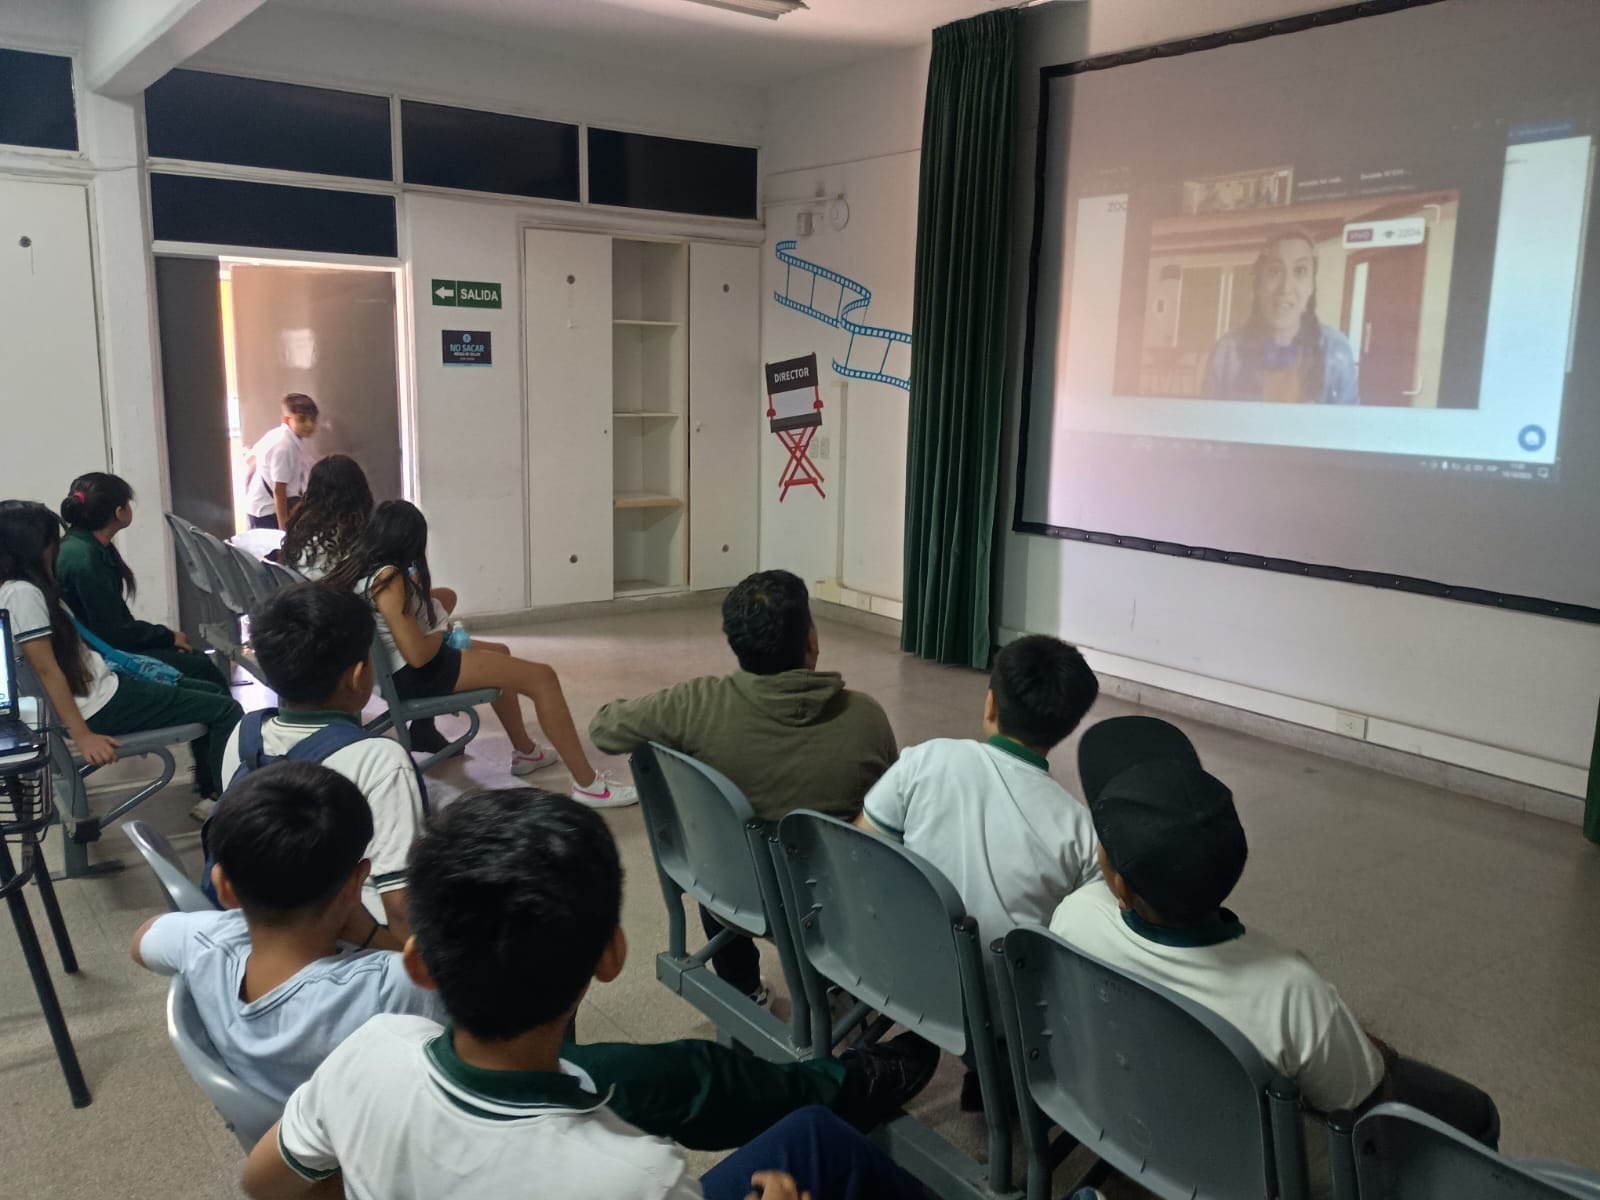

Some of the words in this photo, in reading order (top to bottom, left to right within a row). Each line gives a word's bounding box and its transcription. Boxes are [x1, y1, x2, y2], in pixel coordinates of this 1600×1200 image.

[460, 288, 499, 301] SALIDA
[449, 343, 461, 352] NO
[462, 344, 485, 353] SACAR
[774, 367, 809, 383] DIRECTOR
